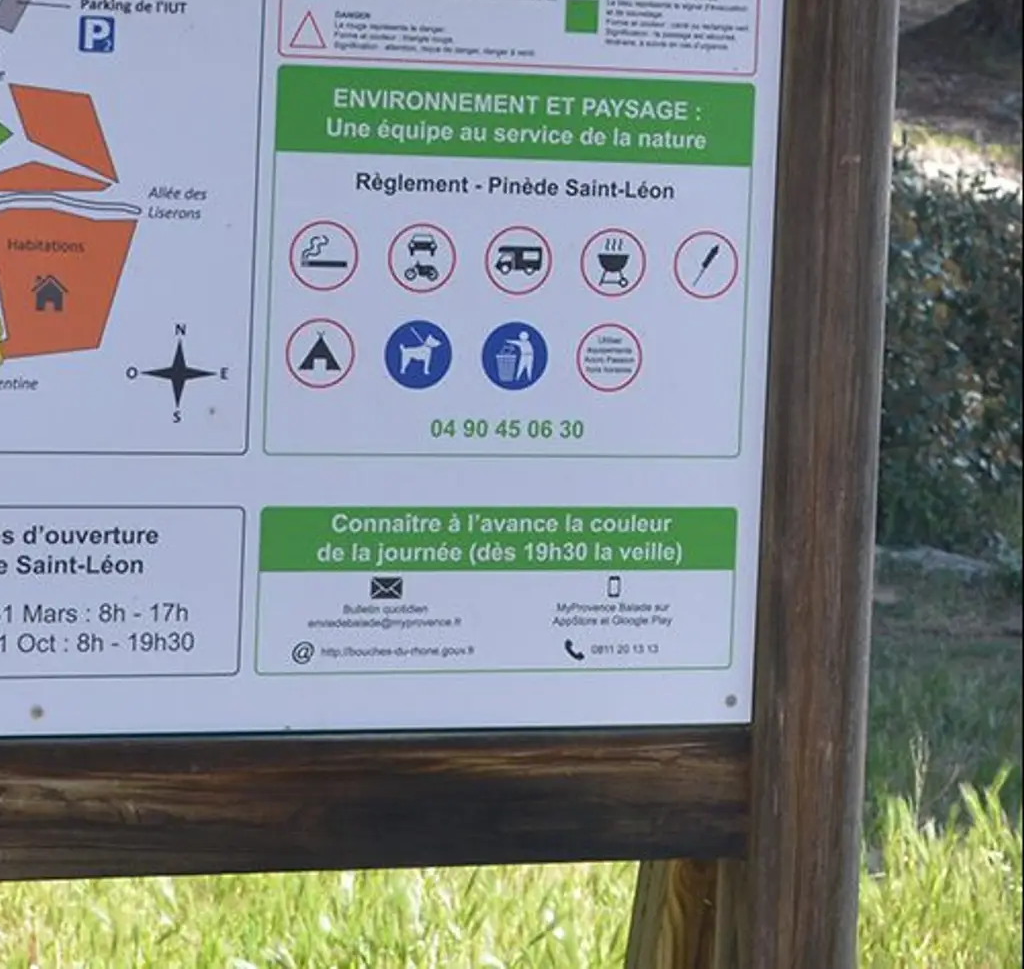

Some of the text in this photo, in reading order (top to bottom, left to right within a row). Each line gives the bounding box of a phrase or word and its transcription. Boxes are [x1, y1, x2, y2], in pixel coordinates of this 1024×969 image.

[134, 0, 153, 13] de
[156, 0, 187, 14] l'IUT
[334, 88, 688, 120] ENVIRONNEMENT ET PAYSAGE
[326, 117, 706, 150] Une équipe au service de la nature
[147, 186, 207, 200] Allée des
[356, 172, 674, 199] Règlement Pinède Saint-Léon
[7, 238, 85, 253] Habitations
[430, 418, 584, 439] 04 90 45 06 30
[448, 513, 460, 533] à
[468, 514, 558, 533] l'avance
[565, 513, 583, 532] la
[590, 514, 672, 533] couleur
[22, 525, 158, 545] d'ouverture
[317, 541, 682, 566] de la journée (dès 19h30 la veille)
[16, 554, 143, 575] Saint-Léon
[23, 603, 77, 624] Mars
[98, 602, 125, 623] 8h
[150, 602, 188, 622] 17h
[17, 633, 56, 653] Oct
[76, 632, 104, 652] 8h
[128, 631, 194, 652] 19h30
